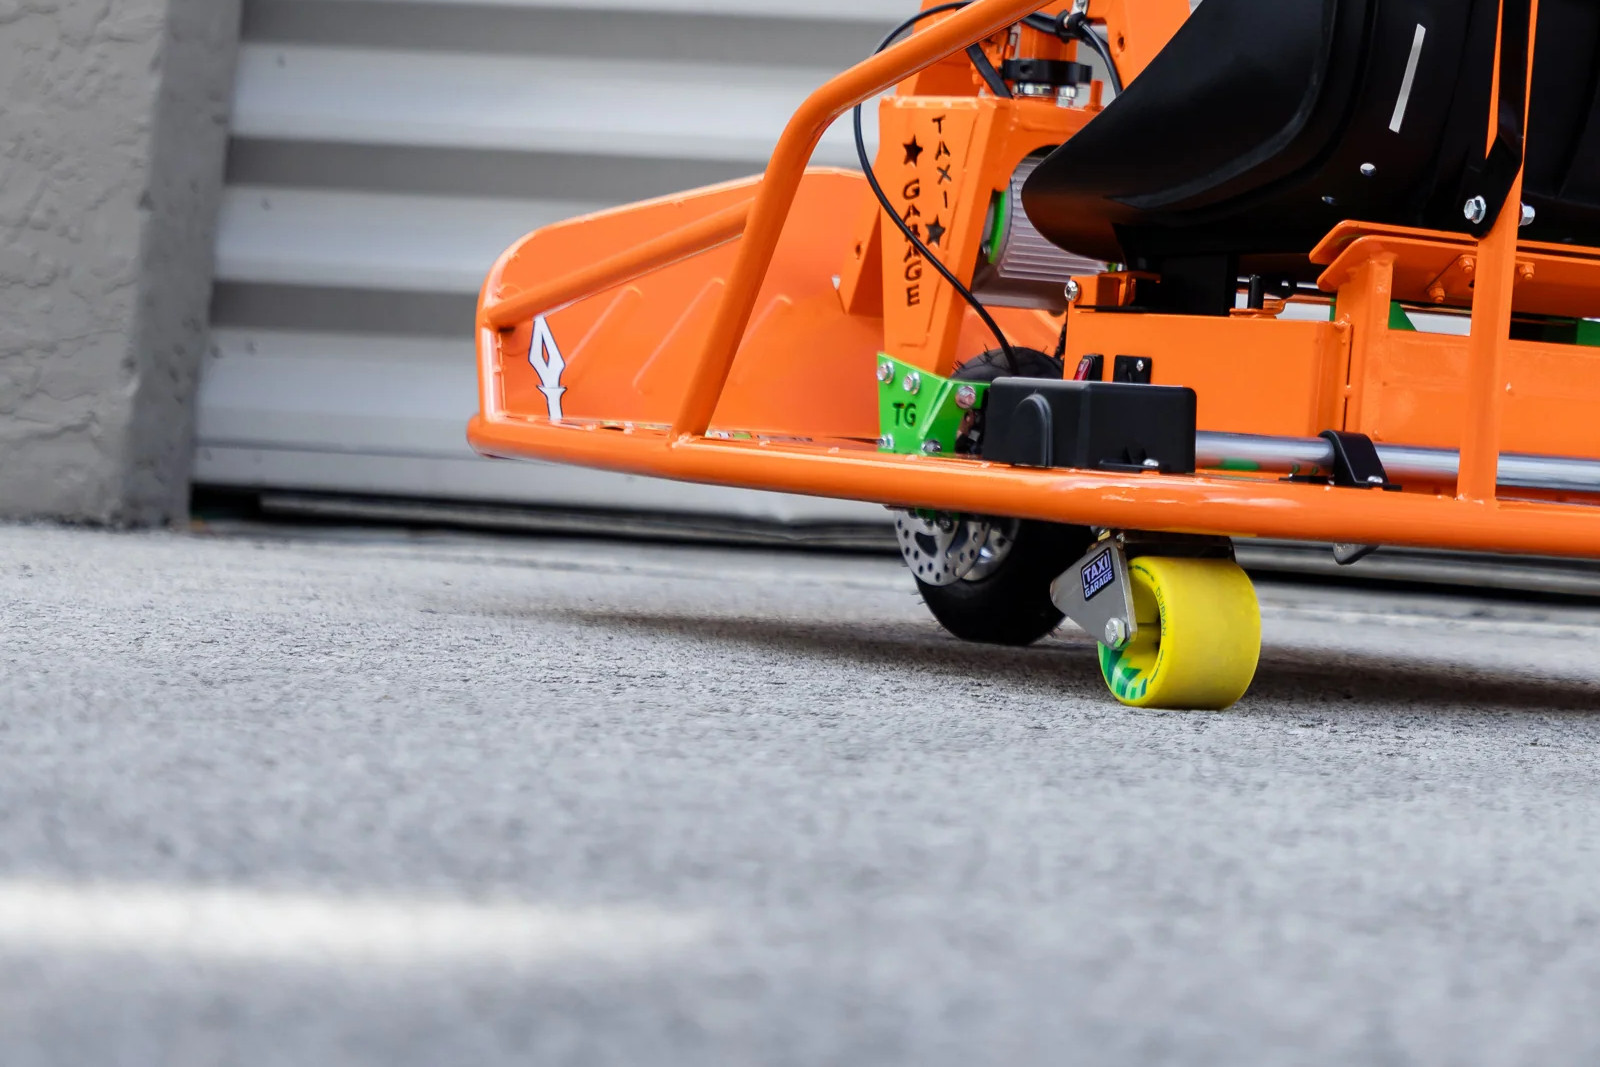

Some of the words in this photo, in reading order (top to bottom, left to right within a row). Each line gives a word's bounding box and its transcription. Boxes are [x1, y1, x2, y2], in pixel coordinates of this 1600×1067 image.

[932, 115, 952, 209] TAXI
[893, 402, 916, 427] TG
[1084, 555, 1109, 583] TAXI
[1085, 570, 1113, 598] GARAGE
[1155, 586, 1167, 636] DURIAN
